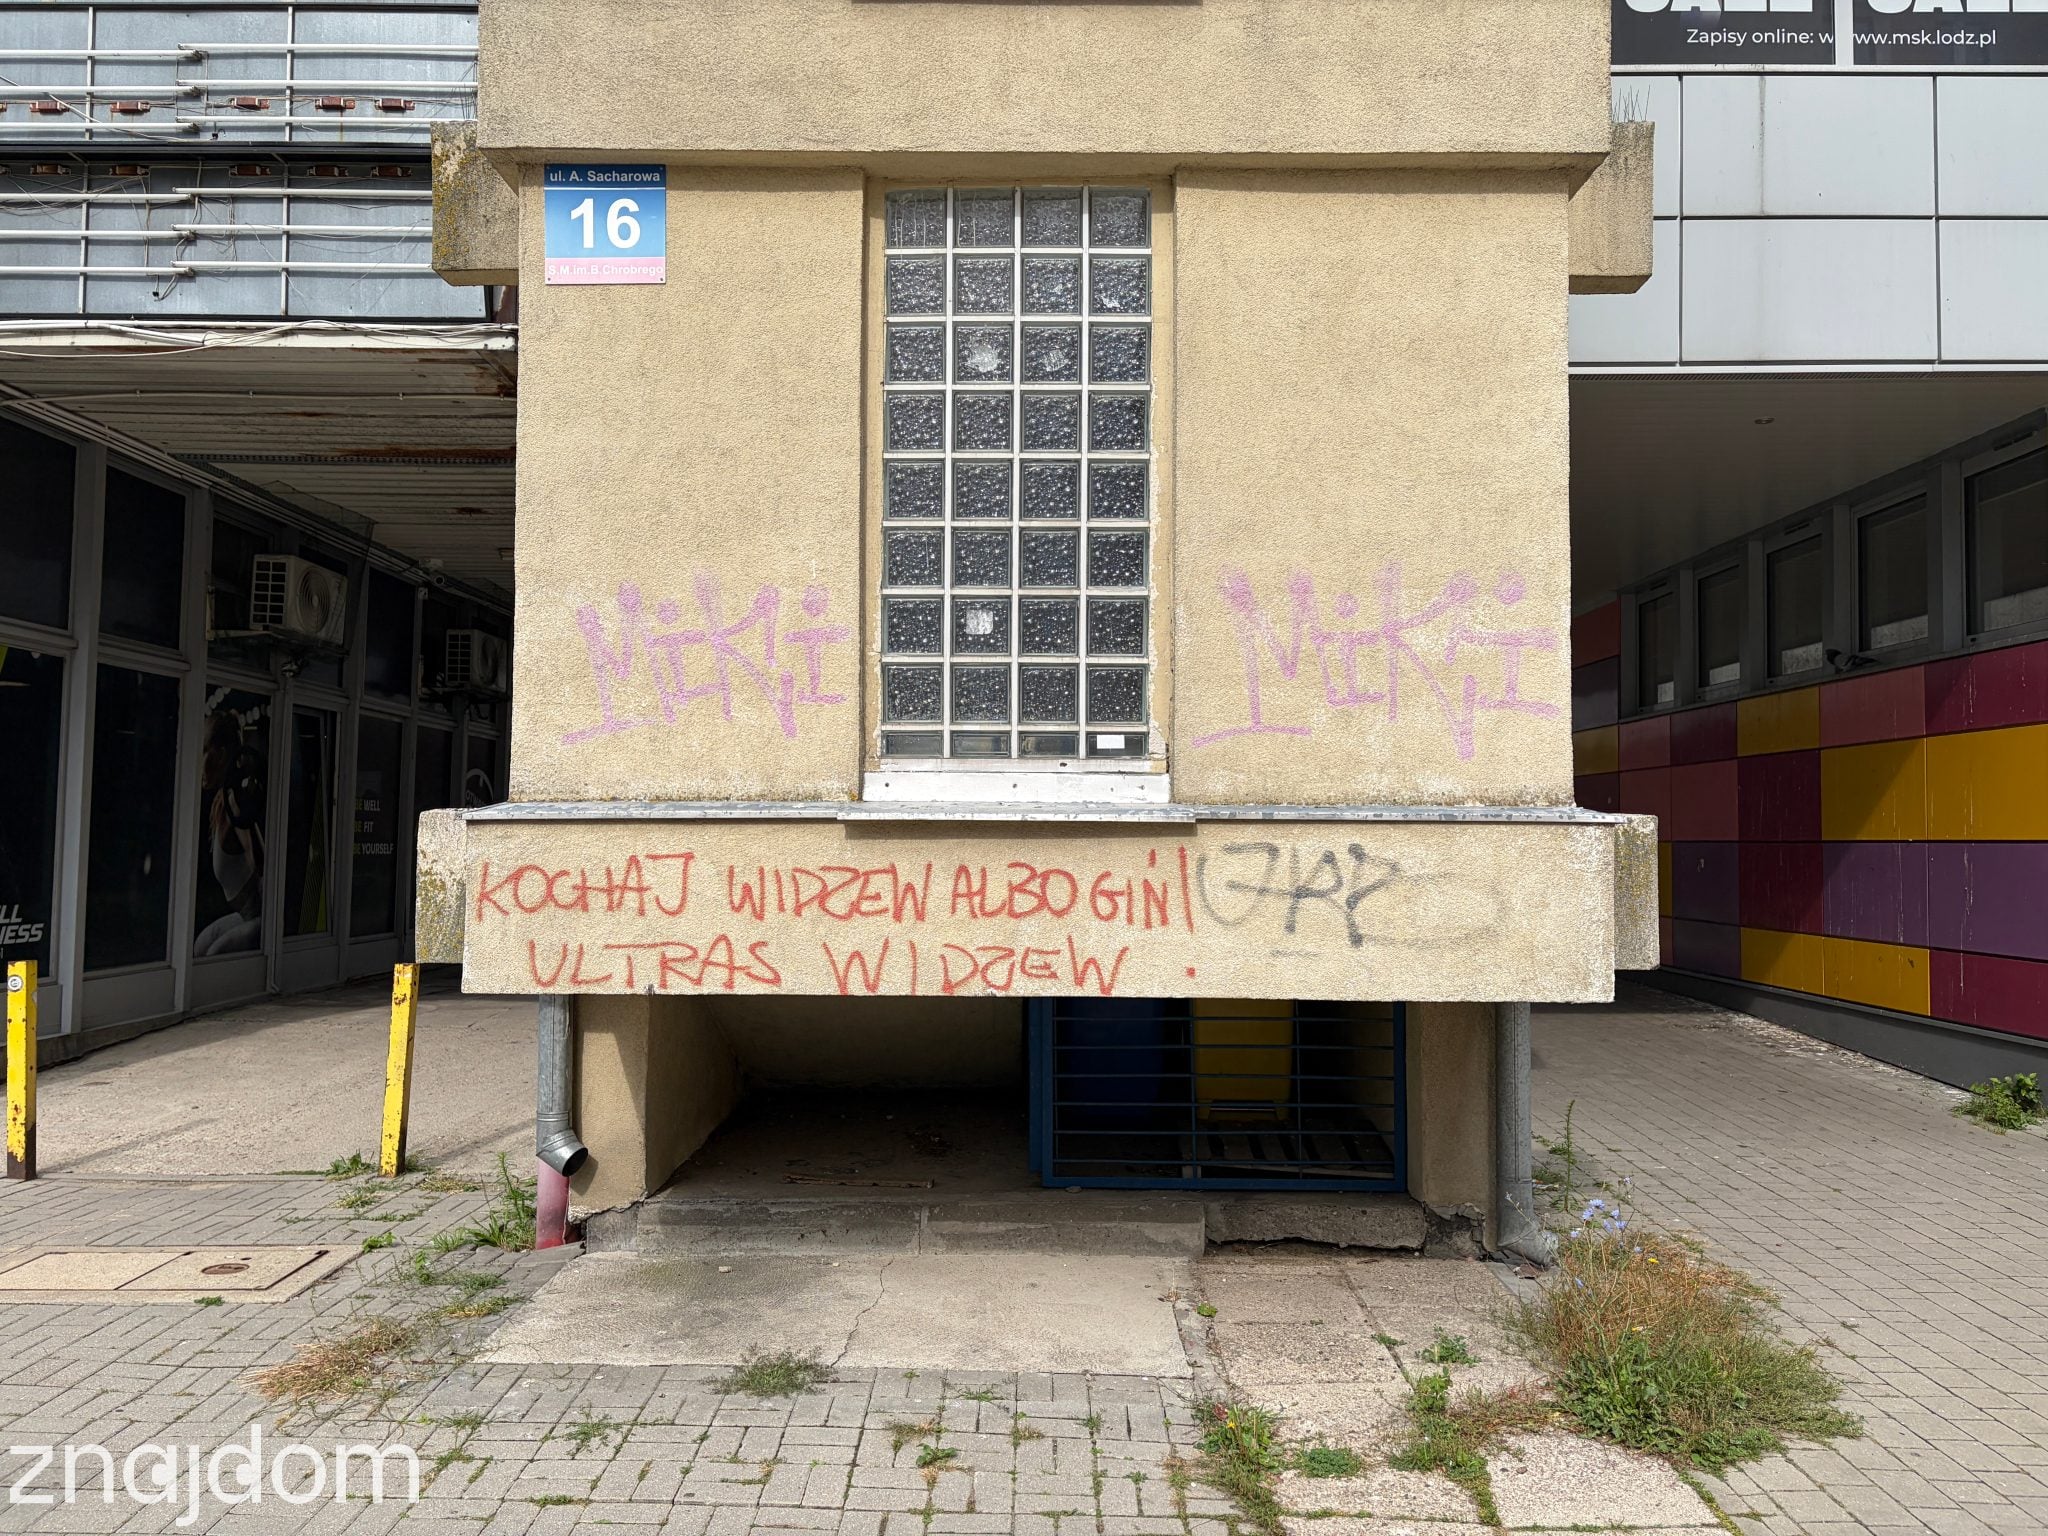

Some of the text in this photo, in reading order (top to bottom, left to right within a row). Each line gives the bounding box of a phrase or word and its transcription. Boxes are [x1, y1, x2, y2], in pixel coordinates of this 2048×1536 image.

[1686, 28, 1748, 46] Zapisy
[1751, 28, 1814, 44] online:
[549, 170, 660, 182] ul. A. Sacharowa
[570, 197, 641, 249] 16
[363, 799, 381, 811] WELL
[363, 821, 374, 833] FIT
[361, 842, 394, 855] YOURSELF
[475, 851, 696, 922] KOCHAJ
[727, 861, 934, 922] WIDZEW
[950, 863, 1079, 920] ALBO
[528, 934, 1130, 996] ULTRAS WIDZEW
